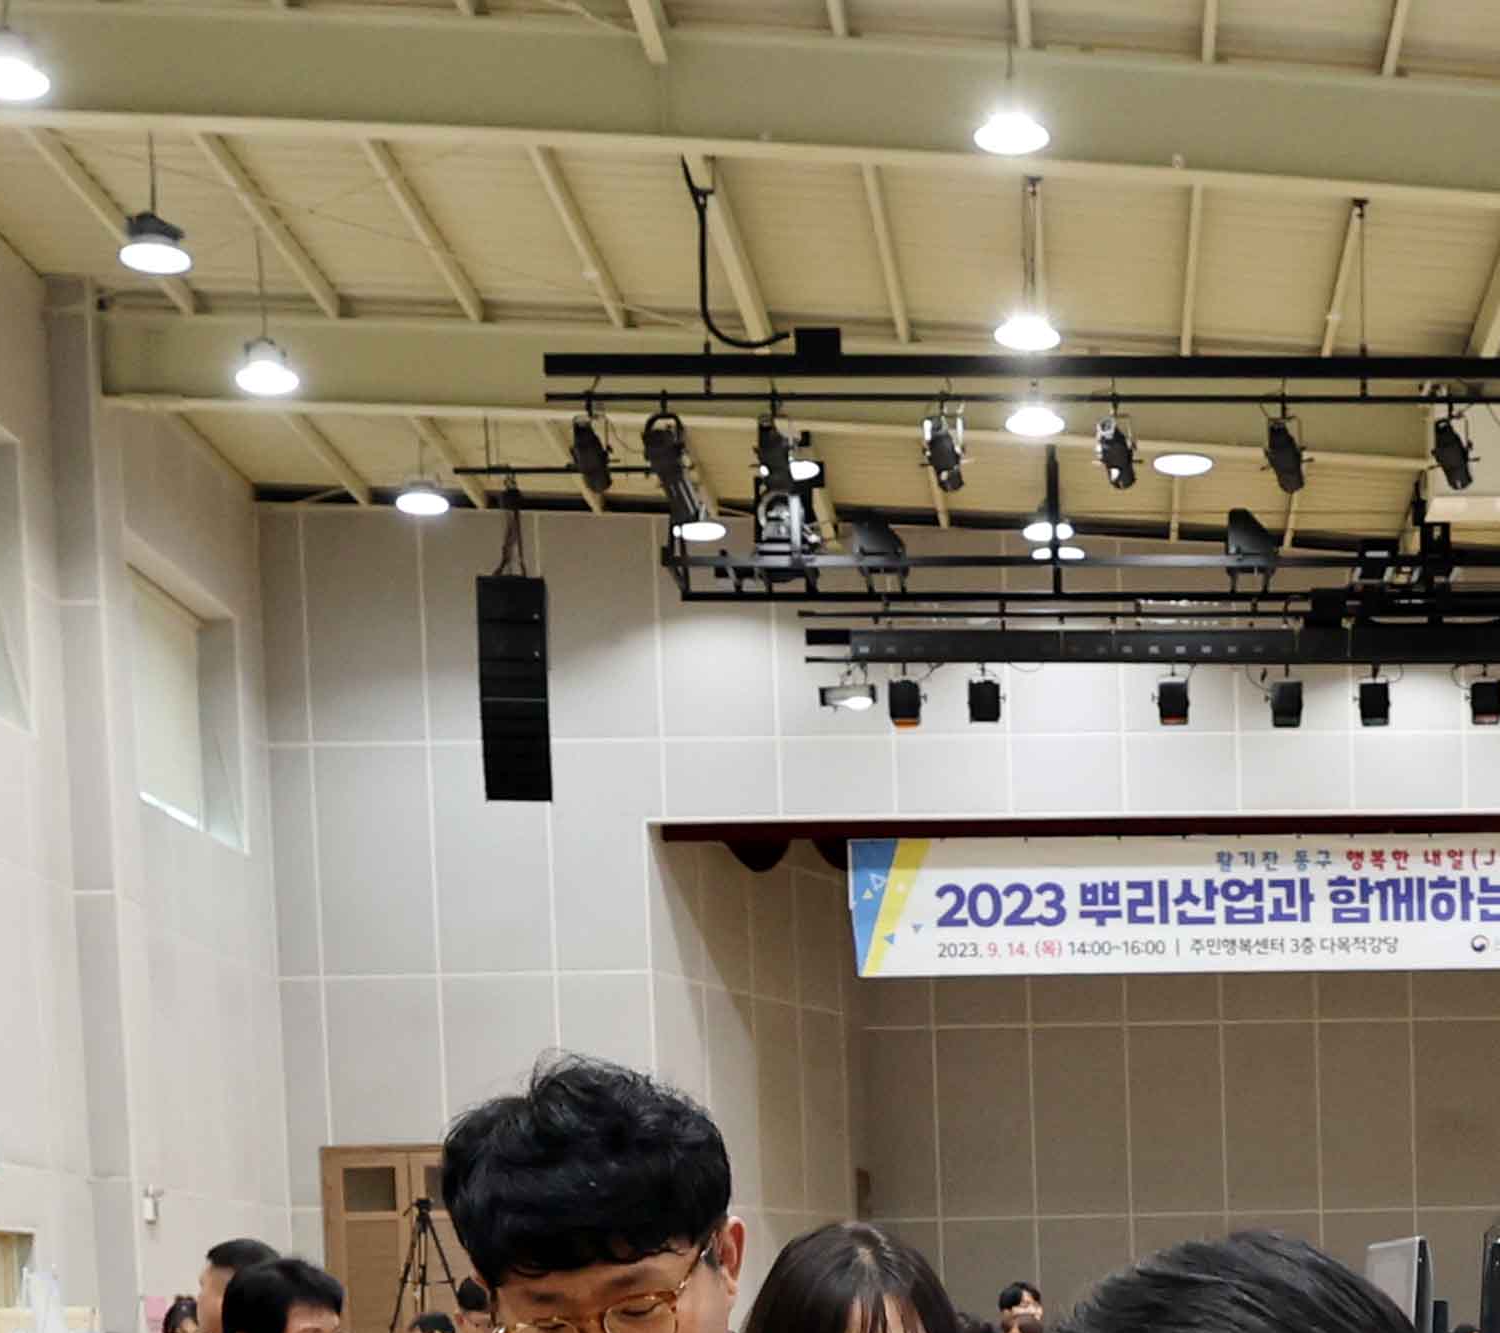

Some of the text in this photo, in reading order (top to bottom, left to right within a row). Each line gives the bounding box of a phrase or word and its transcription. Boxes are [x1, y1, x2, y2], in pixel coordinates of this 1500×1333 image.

[1346, 849, 1410, 872] 행복한
[935, 881, 1067, 928] 2023
[1079, 878, 1315, 928] 뿌리산업과
[937, 941, 982, 958] 2023.
[1190, 936, 1285, 956] 주민행복센터
[1291, 936, 1316, 955] 3층
